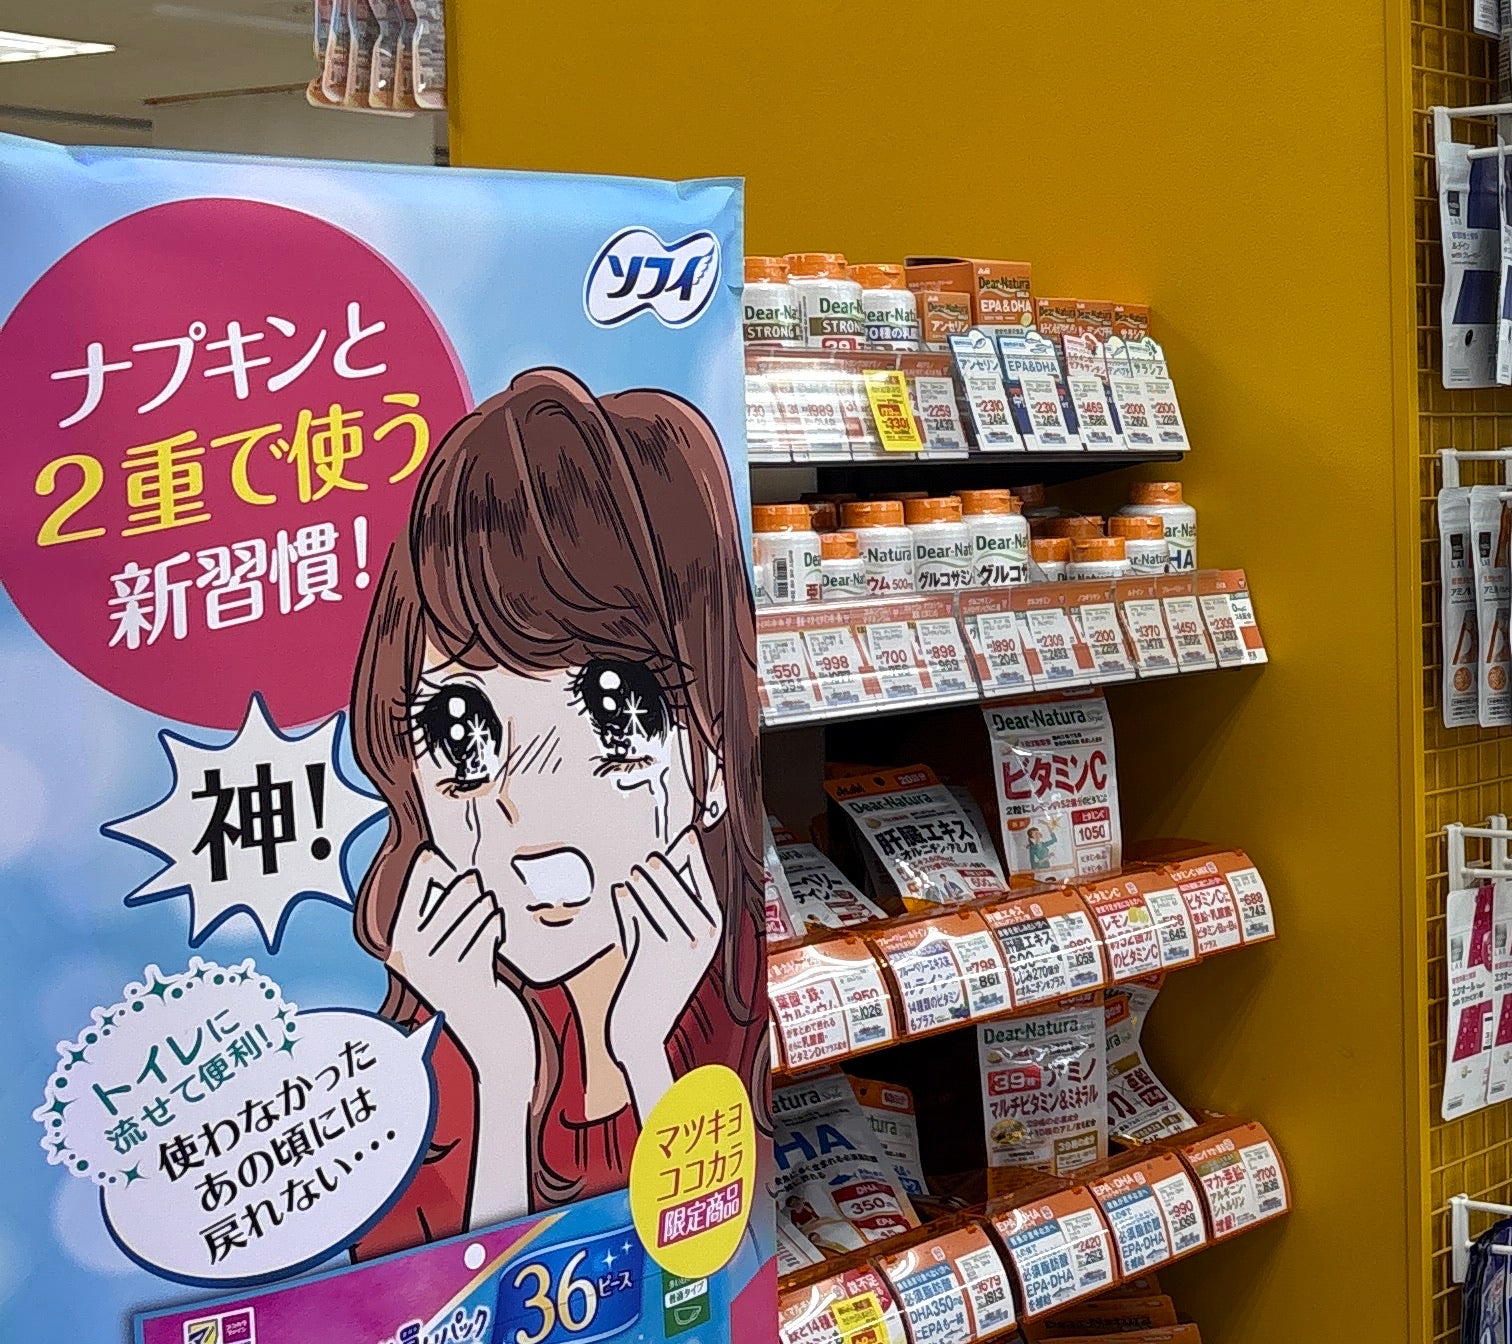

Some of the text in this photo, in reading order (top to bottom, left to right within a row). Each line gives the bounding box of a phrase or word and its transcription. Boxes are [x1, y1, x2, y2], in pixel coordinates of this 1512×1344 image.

[606, 255, 703, 302] ソフィ
[981, 300, 1033, 313] EPA&DHA
[51, 302, 388, 429] ナプキンと
[1008, 360, 1058, 373] EPA&DHA
[34, 392, 431, 547] 2重で使う
[994, 709, 1087, 732] Dear-Natura
[1003, 750, 1108, 800] ビタミンC
[191, 761, 331, 882] 神!
[874, 820, 975, 855] 肝臓エキス
[984, 1019, 1078, 1044] Dear-Natura
[92, 1008, 241, 1115] トイレに
[156, 1037, 377, 1183] 使わなかった
[655, 1102, 744, 1155] マツキヨ
[199, 1087, 378, 1214] あの頃には
[658, 1148, 744, 1202] ココカラ
[661, 1186, 742, 1244] 限定商品
